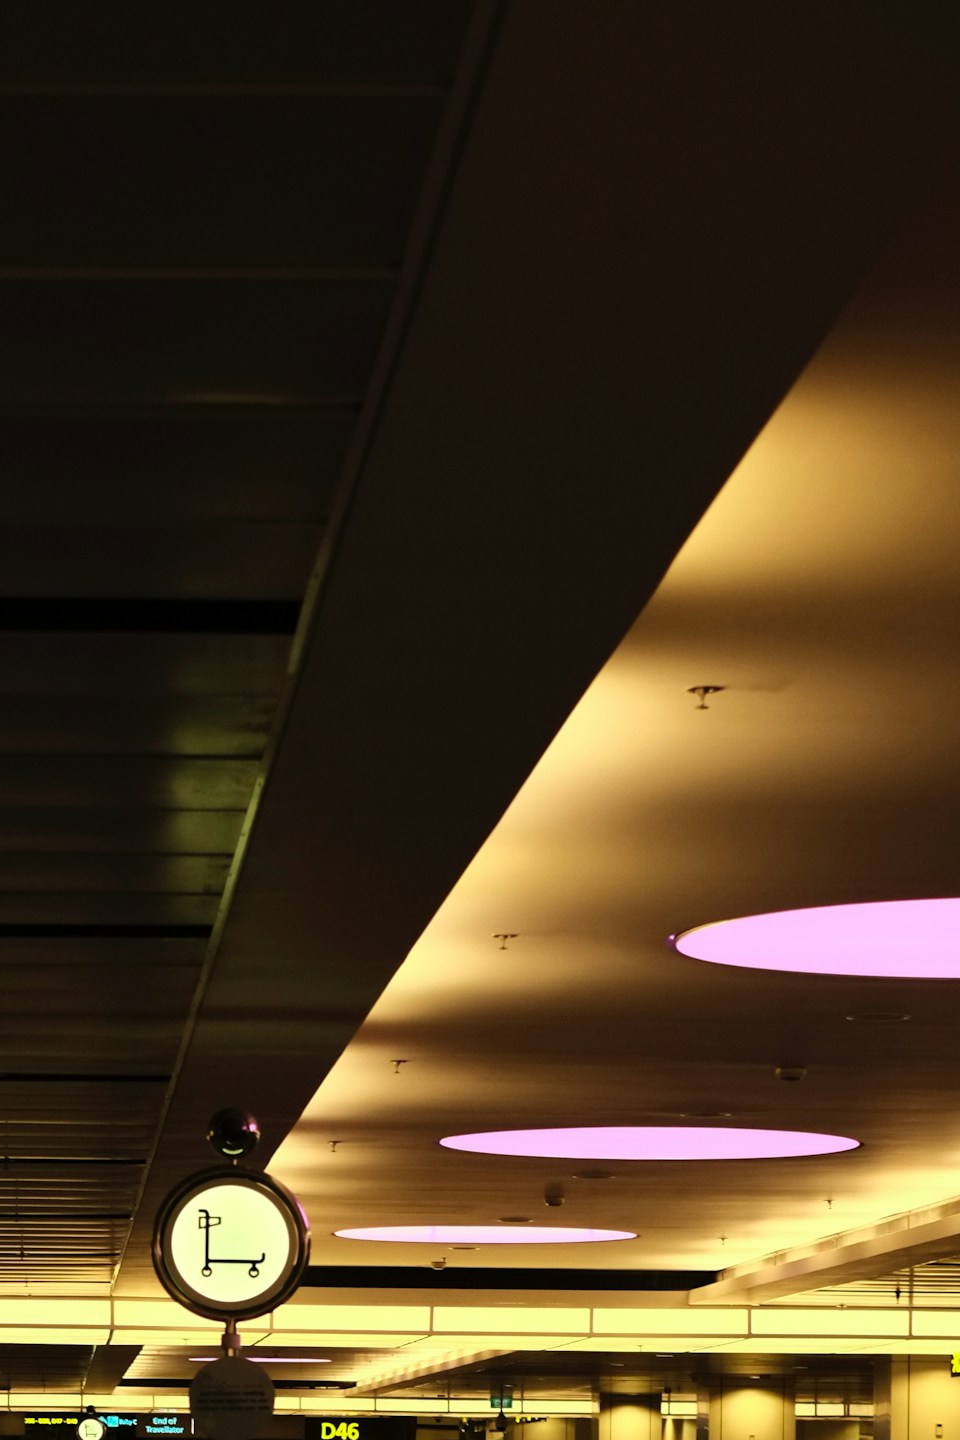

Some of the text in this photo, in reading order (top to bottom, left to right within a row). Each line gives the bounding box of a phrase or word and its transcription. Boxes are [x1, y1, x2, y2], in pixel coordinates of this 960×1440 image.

[152, 1417, 177, 1425] End of
[145, 1426, 184, 1434] Travellator
[320, 1422, 359, 1440] D46
